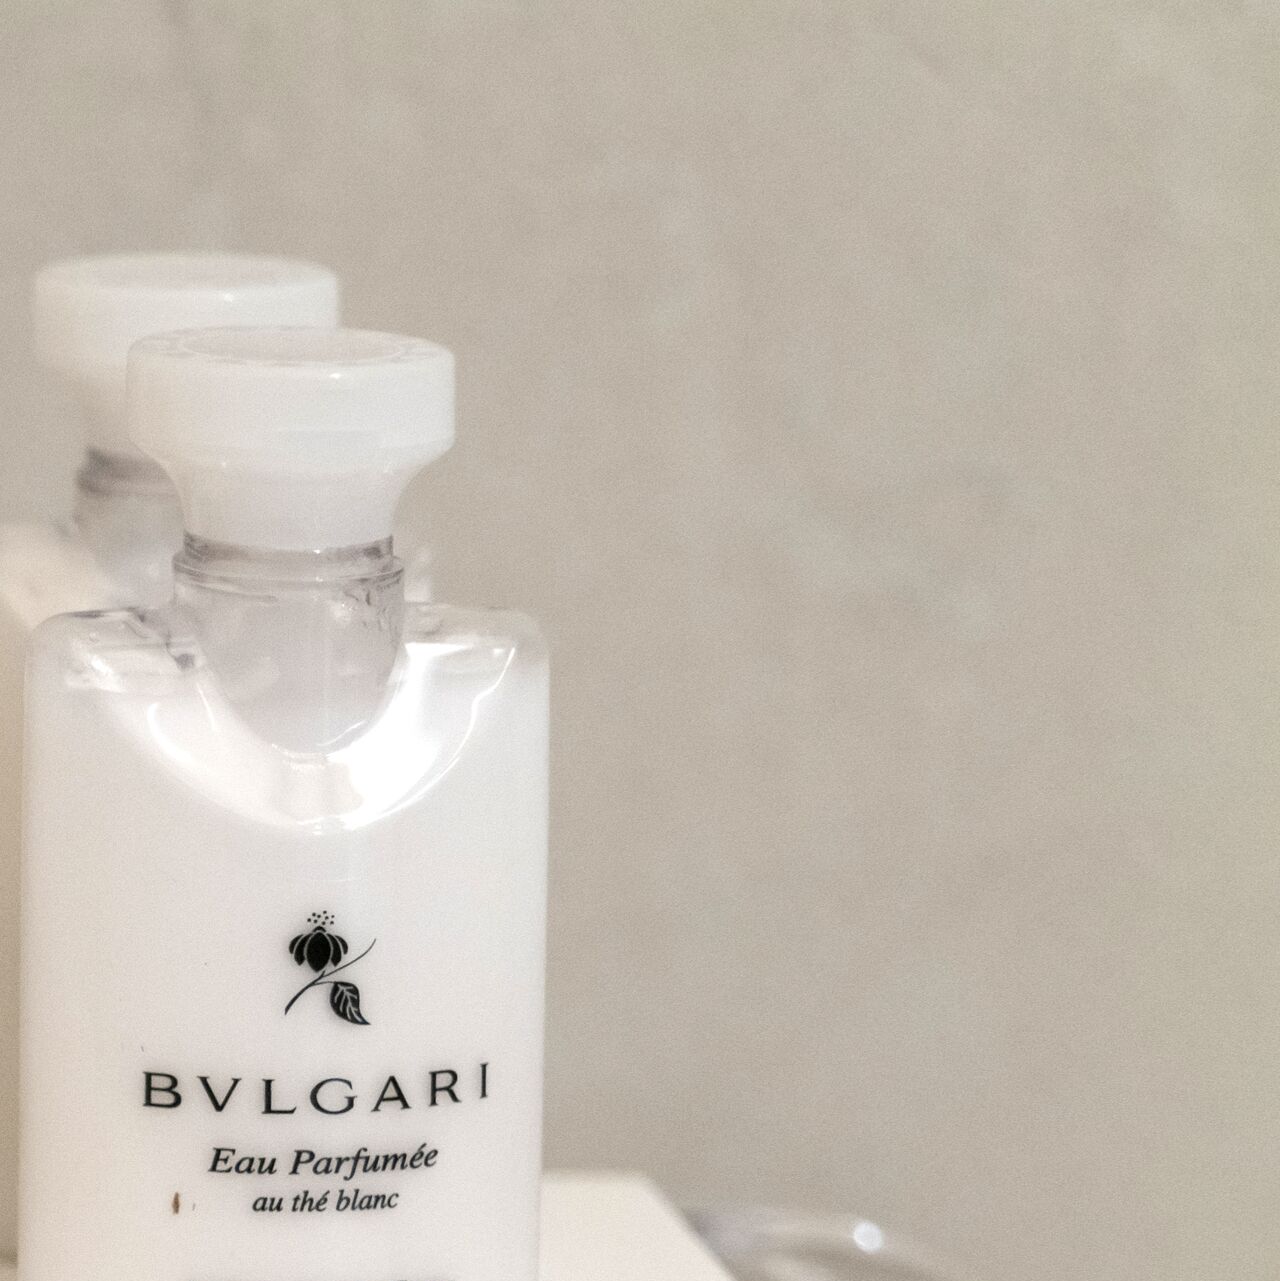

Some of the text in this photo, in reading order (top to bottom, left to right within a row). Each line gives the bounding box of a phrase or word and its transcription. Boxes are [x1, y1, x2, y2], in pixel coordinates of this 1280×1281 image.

[143, 1063, 487, 1115] BVLGARI
[209, 1143, 439, 1181] Eau Parfumée
[252, 1188, 399, 1212] au thé blanc
